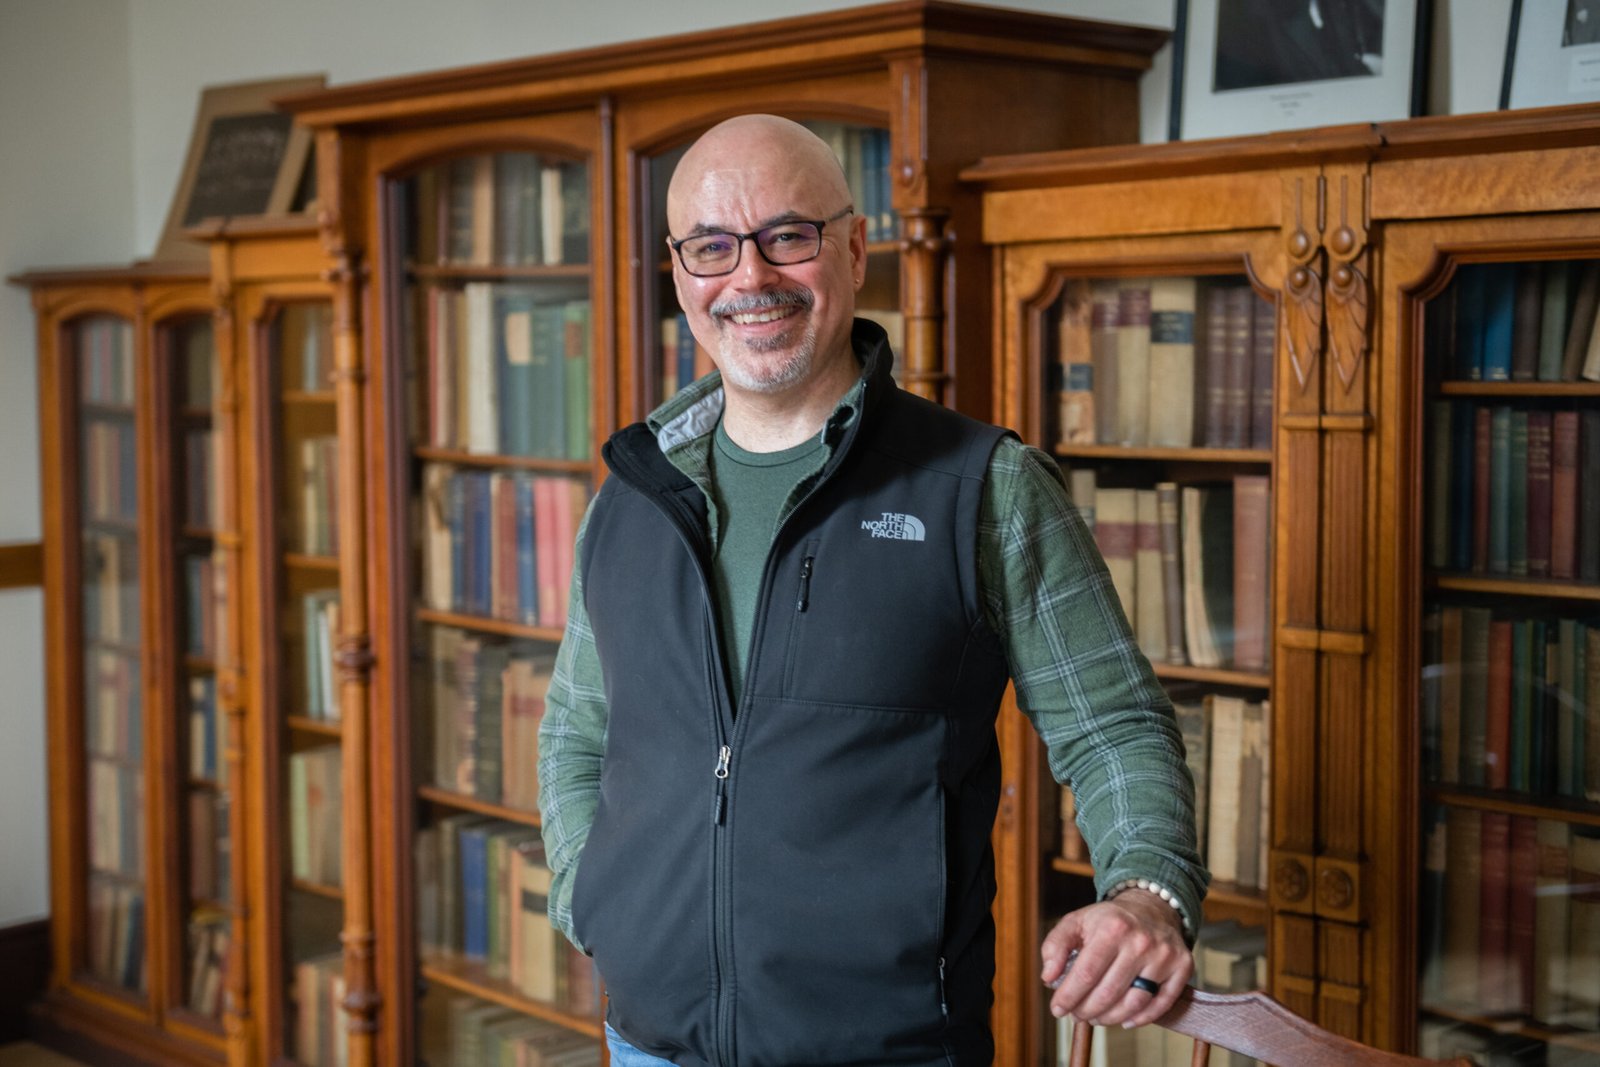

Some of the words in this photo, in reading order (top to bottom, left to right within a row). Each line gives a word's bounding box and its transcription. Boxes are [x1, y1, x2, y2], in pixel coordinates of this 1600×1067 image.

[881, 512, 904, 523] THE
[861, 520, 903, 531] NORTH
[871, 529, 902, 540] FACE
